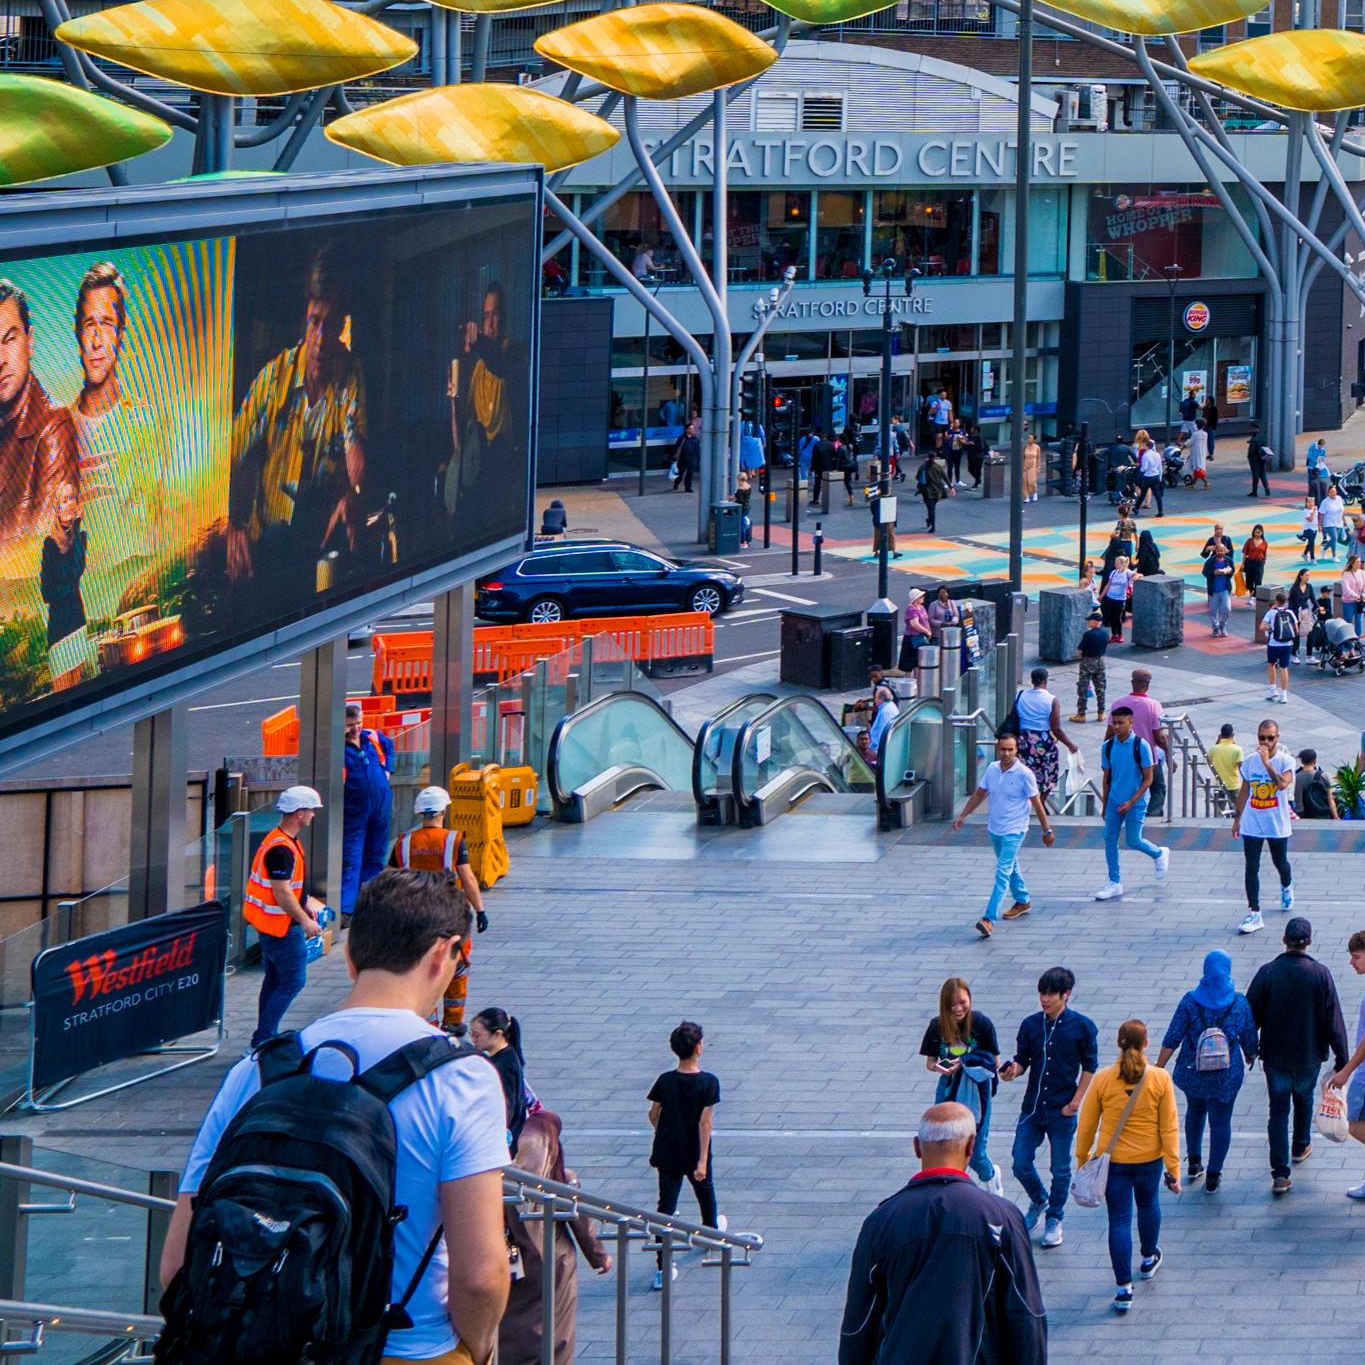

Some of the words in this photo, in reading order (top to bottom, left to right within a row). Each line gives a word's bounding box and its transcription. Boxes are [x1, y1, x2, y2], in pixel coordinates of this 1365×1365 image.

[1107, 208, 1193, 239] WHOPPER
[1187, 315, 1207, 323] KING
[1250, 779, 1278, 799] TOY
[64, 931, 197, 1007] Westfield
[63, 993, 141, 1031] STRATFORD
[144, 980, 176, 1001] CITY
[177, 972, 199, 990] E20
